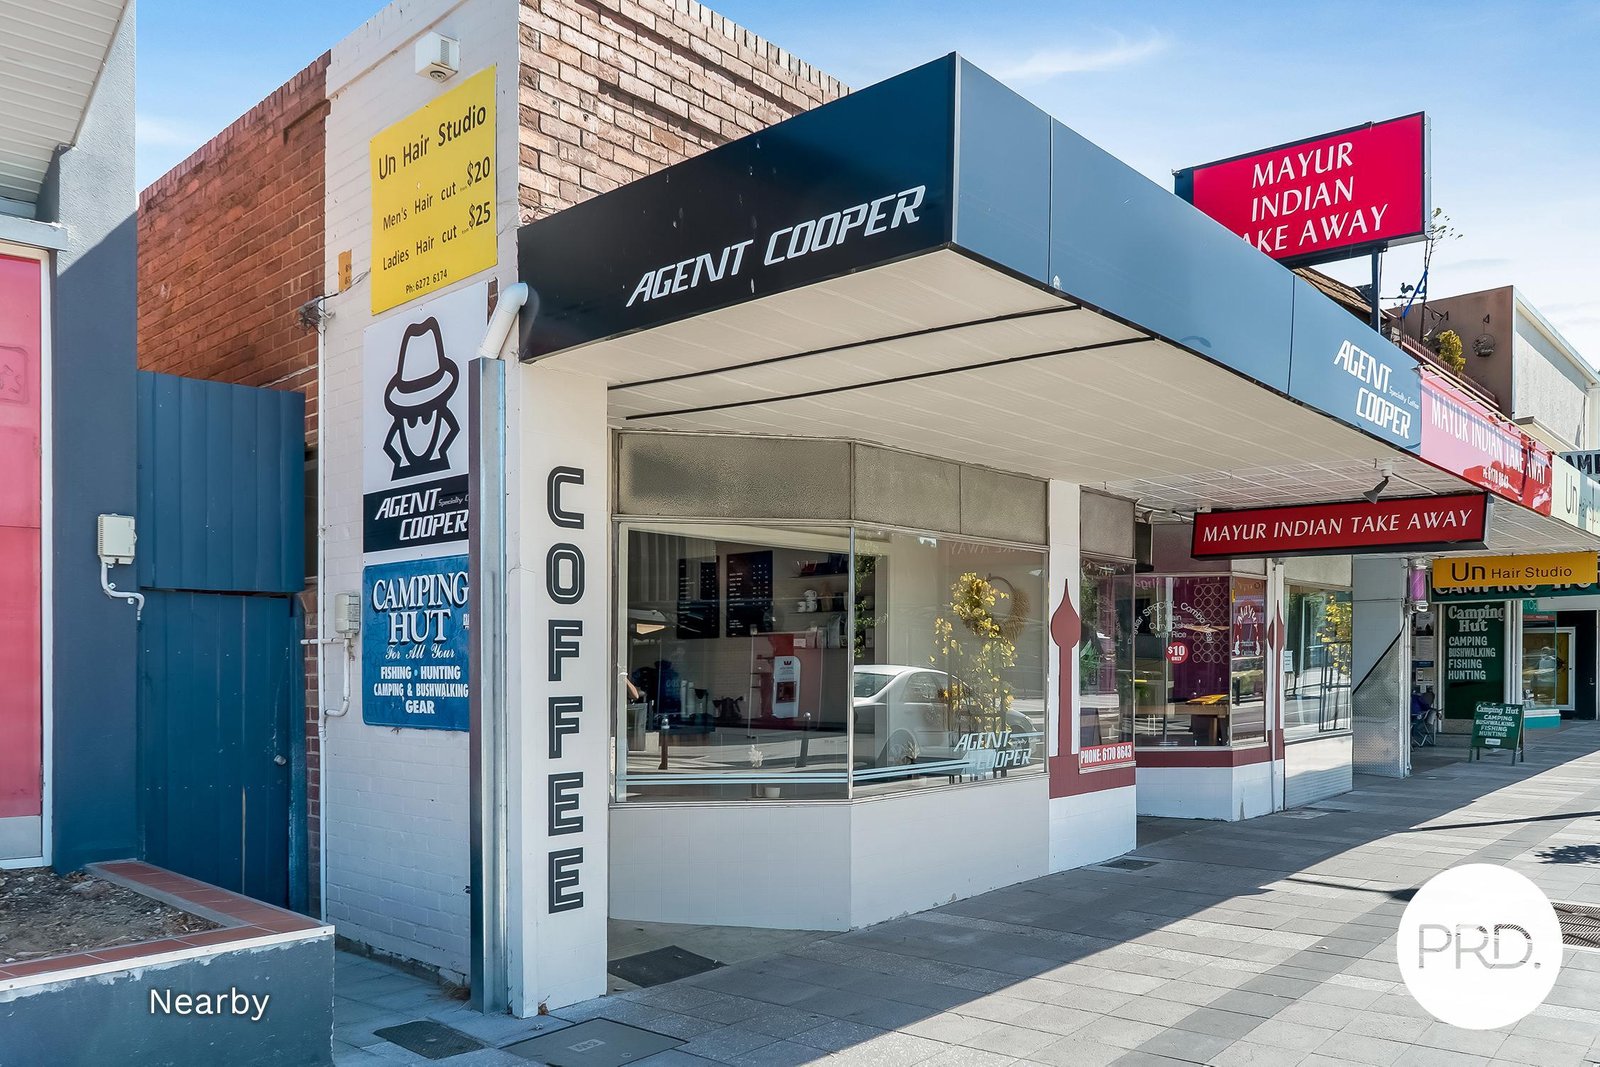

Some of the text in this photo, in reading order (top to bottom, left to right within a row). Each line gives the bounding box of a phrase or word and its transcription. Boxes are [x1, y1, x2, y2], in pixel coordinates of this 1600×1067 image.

[378, 104, 486, 180] Un Hair Studio
[1252, 141, 1353, 189] MAYUR
[383, 156, 491, 231] Men's Hair cut $20
[1251, 176, 1354, 222] INDIAN
[383, 201, 491, 271] Ladies Hair cut $25
[1242, 204, 1389, 253] AKE AWAY
[625, 184, 926, 308] AGENT COOPER
[433, 269, 448, 284] 6174
[1333, 339, 1393, 394] AGENT
[1355, 387, 1411, 439] COOPER
[1431, 390, 1546, 485] MAYUR INDIAN TAKE AWAY
[375, 487, 442, 520] AGENT
[1565, 471, 1578, 516] Un
[399, 508, 469, 541] COOPER
[1203, 508, 1473, 543] MAYUR INDIAN TAKE AWAY
[1451, 562, 1573, 582] Un Hair Studio
[372, 570, 469, 612] CAMPING
[389, 608, 451, 643] HUT
[1180, 602, 1206, 624] Combo
[1448, 604, 1505, 625] Camping
[1459, 619, 1489, 633] Hut
[385, 643, 456, 660] For All Your
[1167, 645, 1185, 655] $10
[1448, 636, 1488, 646] CAMPING
[1448, 647, 1496, 658] BUSHWALKING
[381, 665, 461, 680] FISHING HUNTING
[1448, 659, 1483, 669] FISHING
[1448, 670, 1487, 680] HUNTING
[373, 682, 469, 698] CAMPING & BUSHWALKING
[546, 465, 585, 914] COFFEE
[405, 699, 435, 714] GEAR
[953, 731, 1012, 752] AGENT
[1080, 744, 1132, 764] PHONE: 6170 8643
